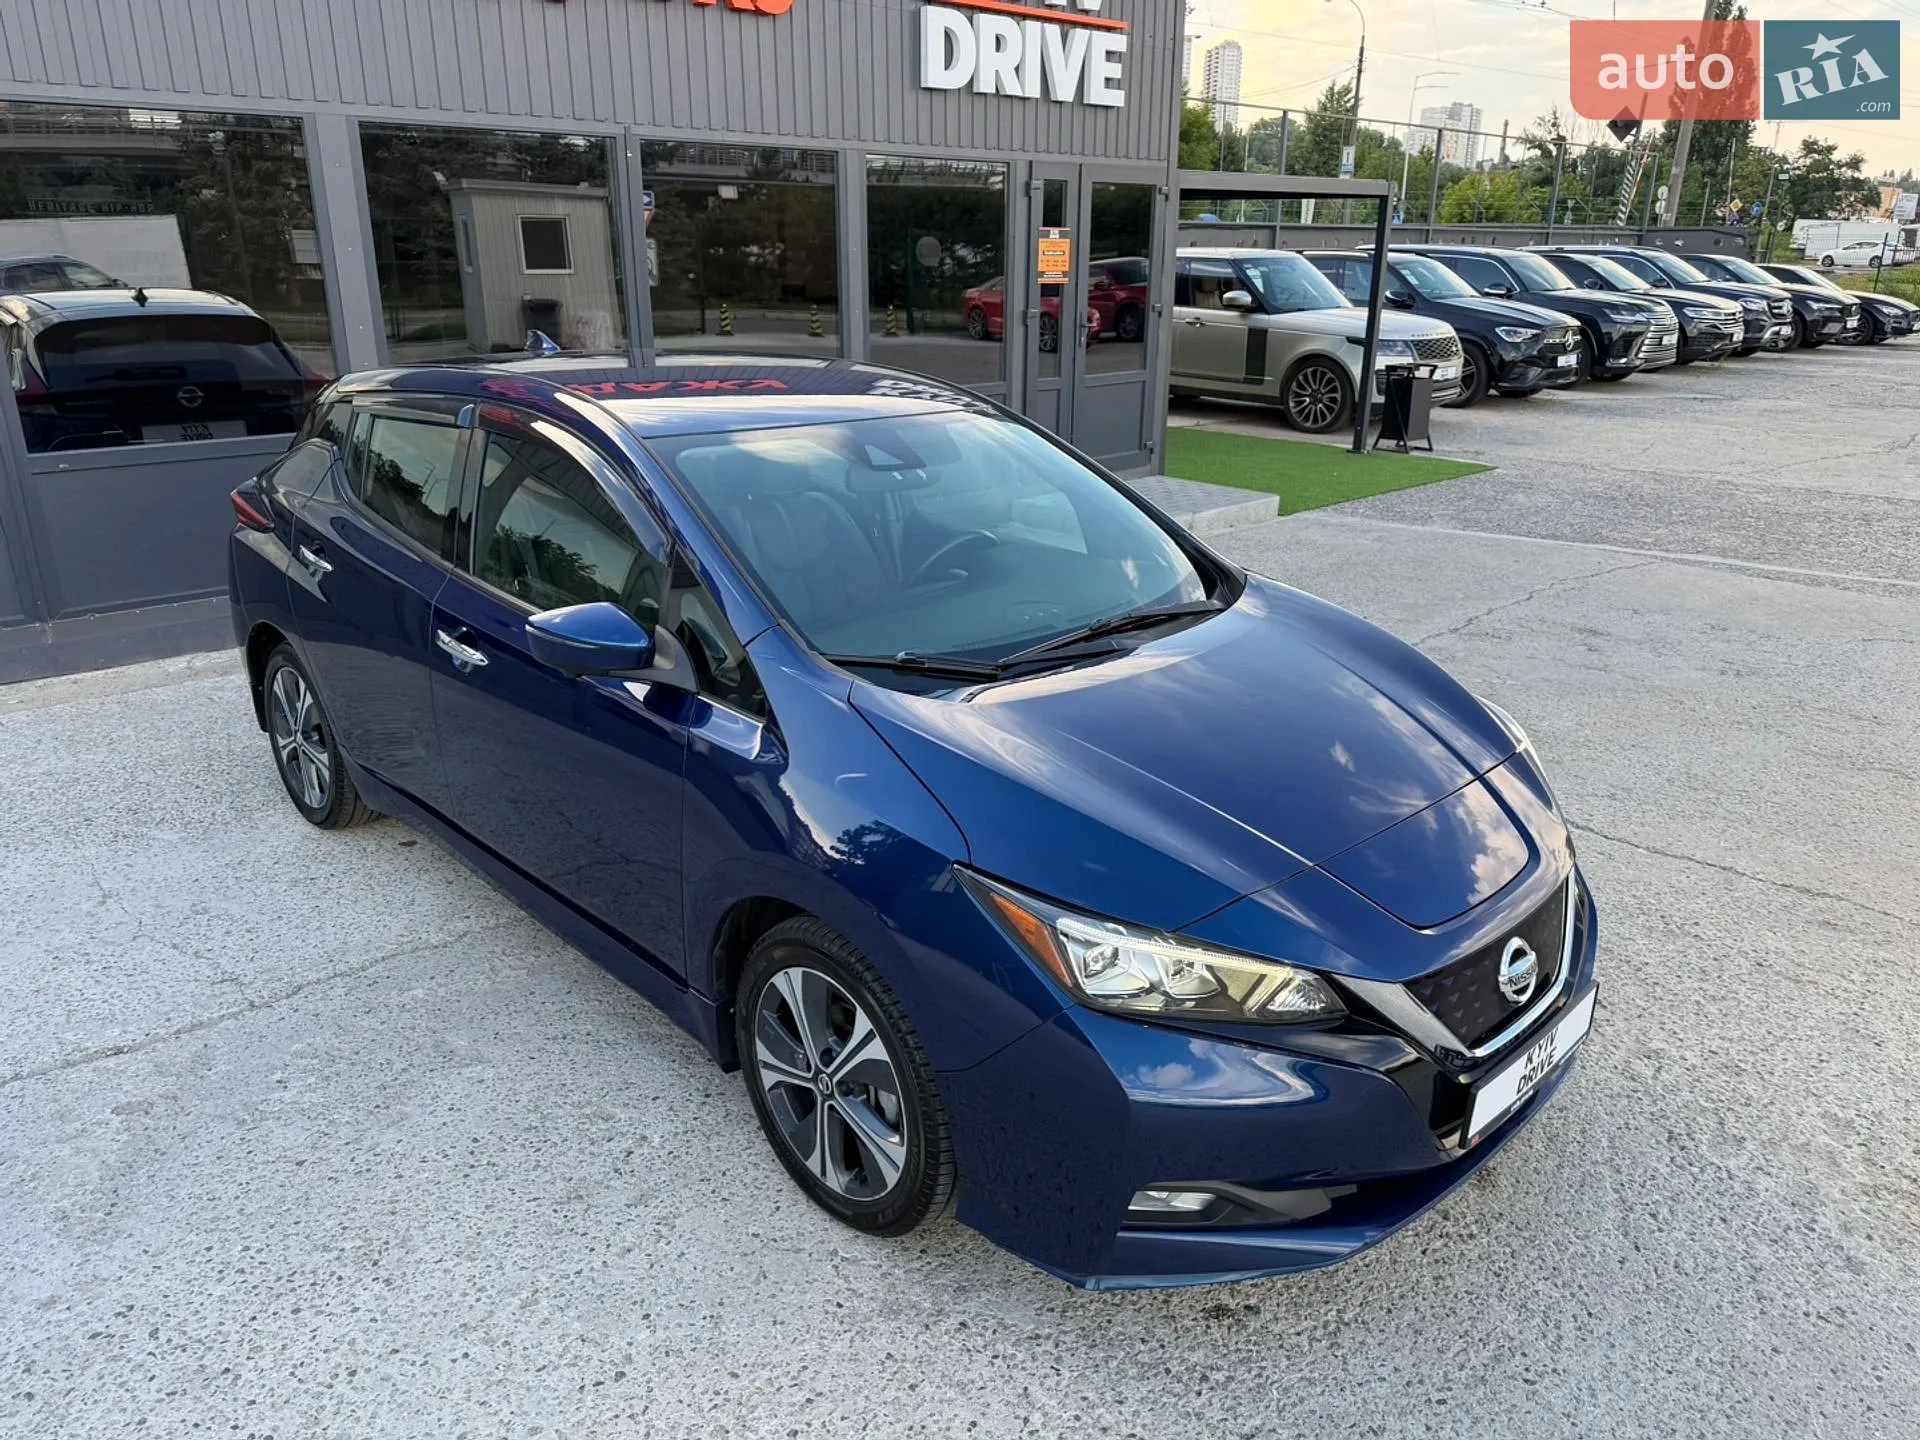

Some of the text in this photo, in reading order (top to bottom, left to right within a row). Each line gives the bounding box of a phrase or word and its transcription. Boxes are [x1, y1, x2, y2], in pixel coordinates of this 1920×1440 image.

[920, 5, 1127, 107] DRIVE
[1516, 1044, 1558, 1095] DRIVE
[1524, 1024, 1560, 1070] KYIV
